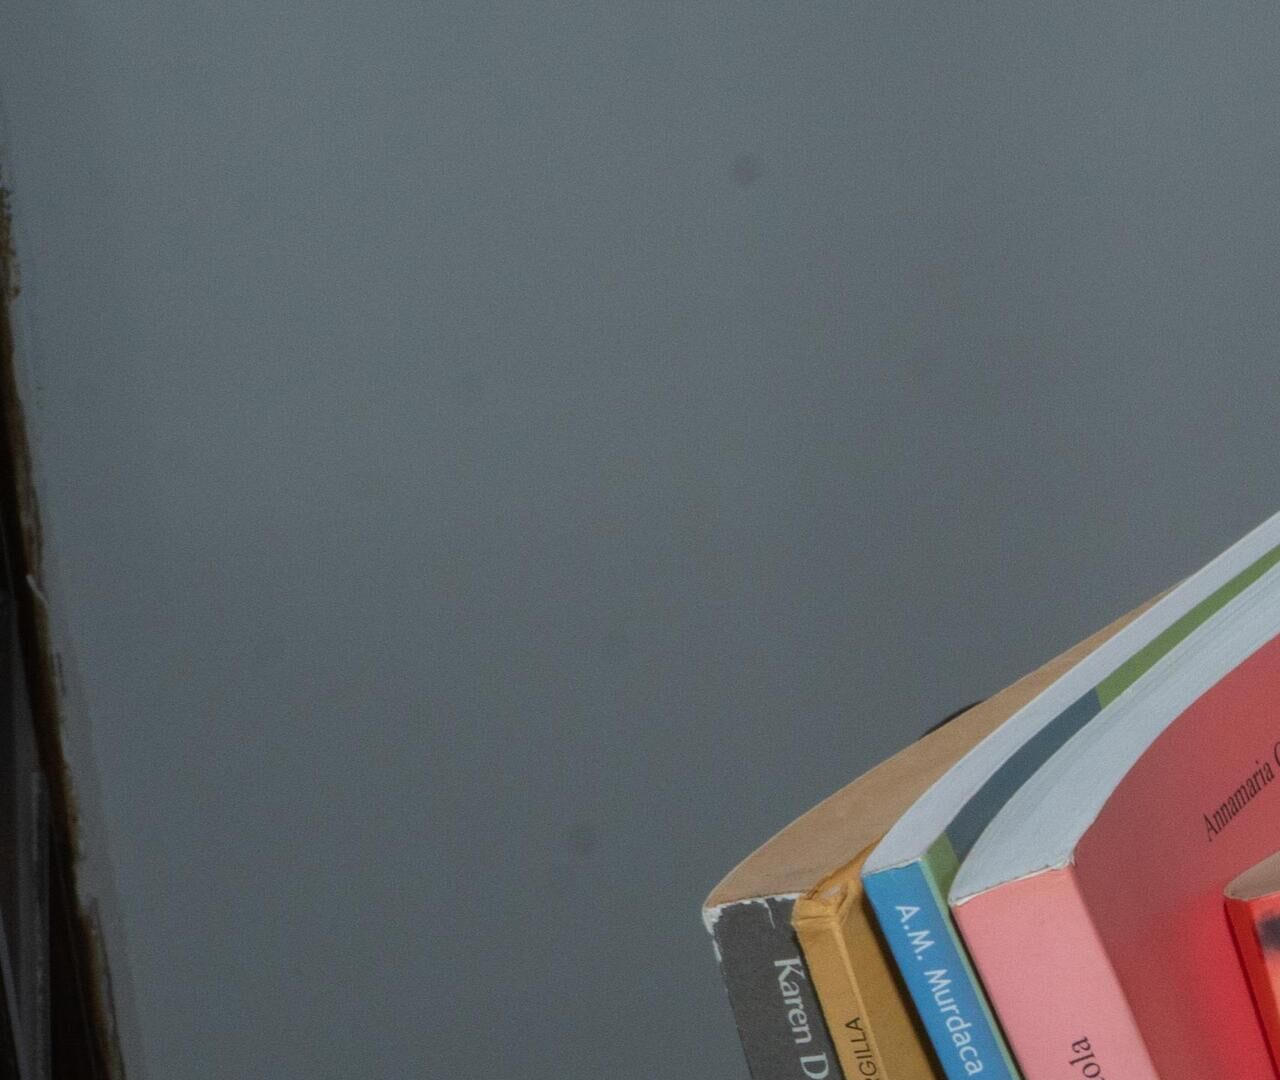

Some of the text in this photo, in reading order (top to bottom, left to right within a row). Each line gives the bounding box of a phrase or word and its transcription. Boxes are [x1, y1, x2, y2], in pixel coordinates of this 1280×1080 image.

[1202, 759, 1275, 843] Annamaria
[773, 954, 813, 1046] Karen
[895, 904, 985, 1077] A.M. Murdaca
